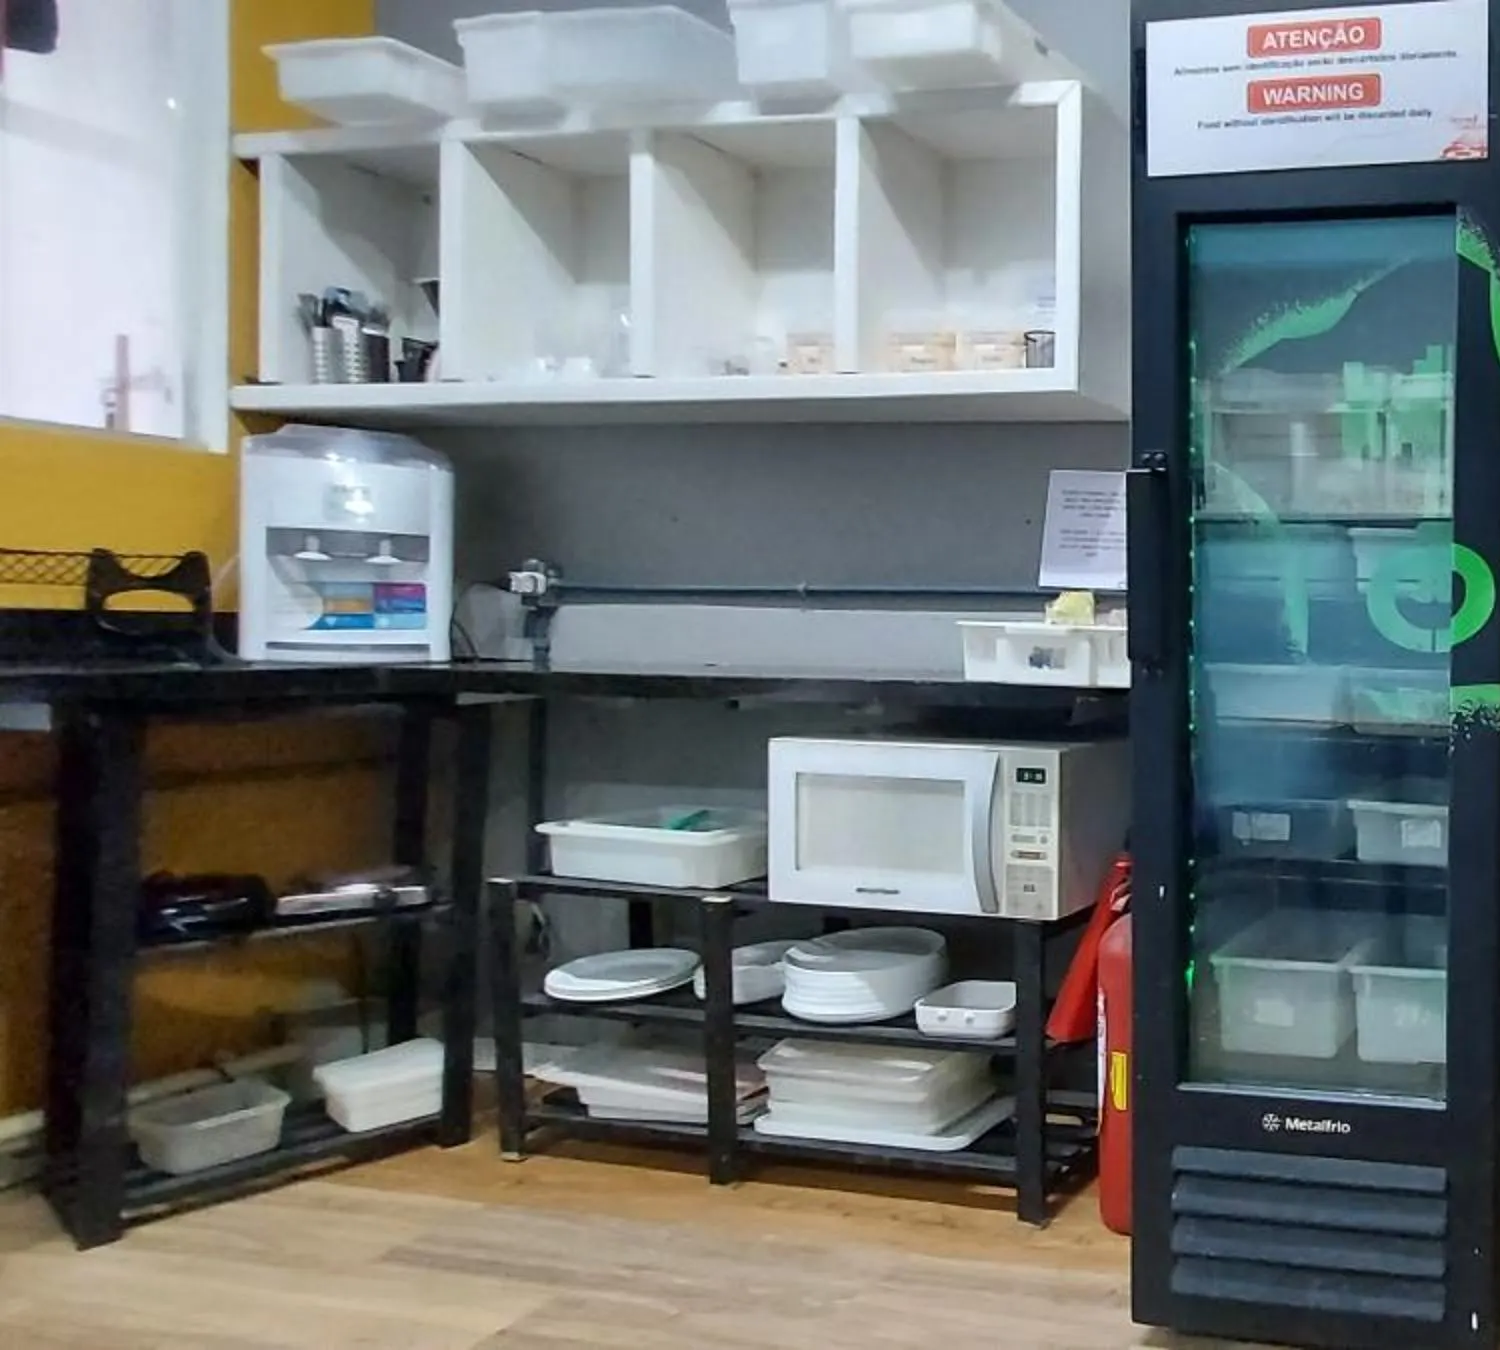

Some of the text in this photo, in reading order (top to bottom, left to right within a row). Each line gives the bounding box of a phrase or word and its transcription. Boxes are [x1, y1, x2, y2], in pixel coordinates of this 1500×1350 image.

[1262, 22, 1366, 50] ATENÇÃO
[1263, 82, 1365, 106] WARNING
[1223, 118, 1258, 128] without
[1260, 113, 1322, 127] identification
[1325, 112, 1341, 122] will
[1344, 111, 1355, 121] be
[1284, 1116, 1352, 1134] Metalfrio
